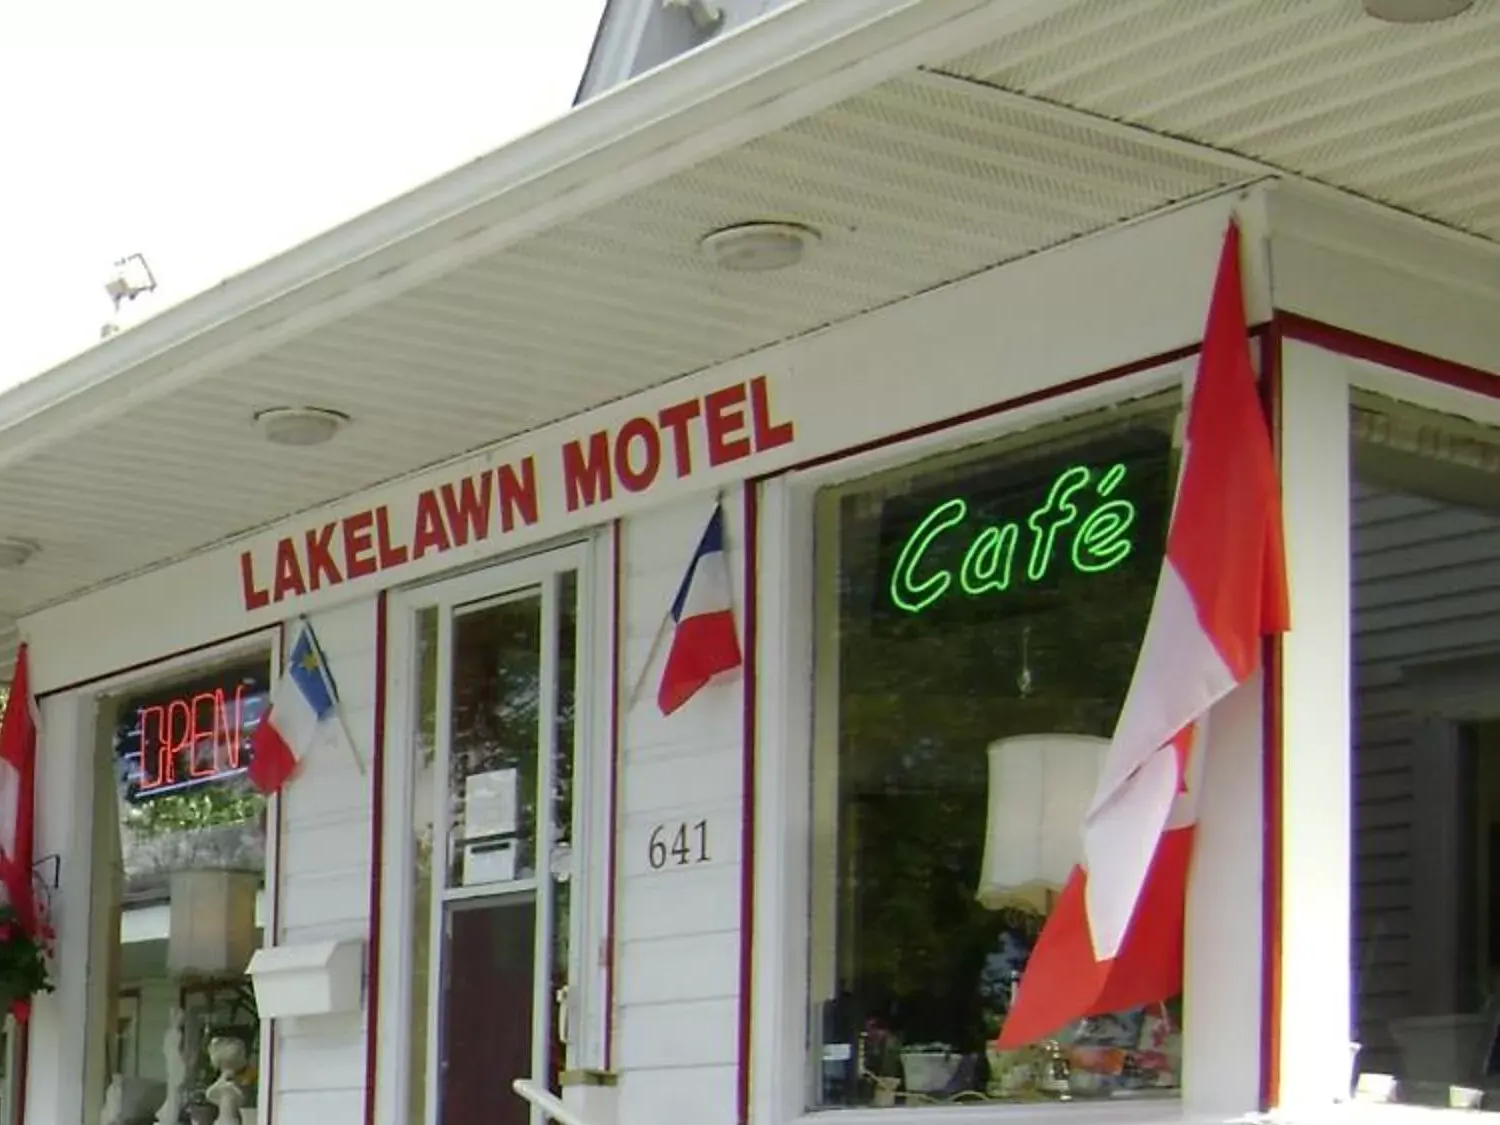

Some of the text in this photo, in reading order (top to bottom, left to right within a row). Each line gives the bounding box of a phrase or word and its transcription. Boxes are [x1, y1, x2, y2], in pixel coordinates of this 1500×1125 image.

[239, 374, 794, 611] LAKELAWN MOTEL
[891, 463, 1134, 611] Café
[138, 684, 247, 789] OPEN
[649, 818, 713, 869] 641
